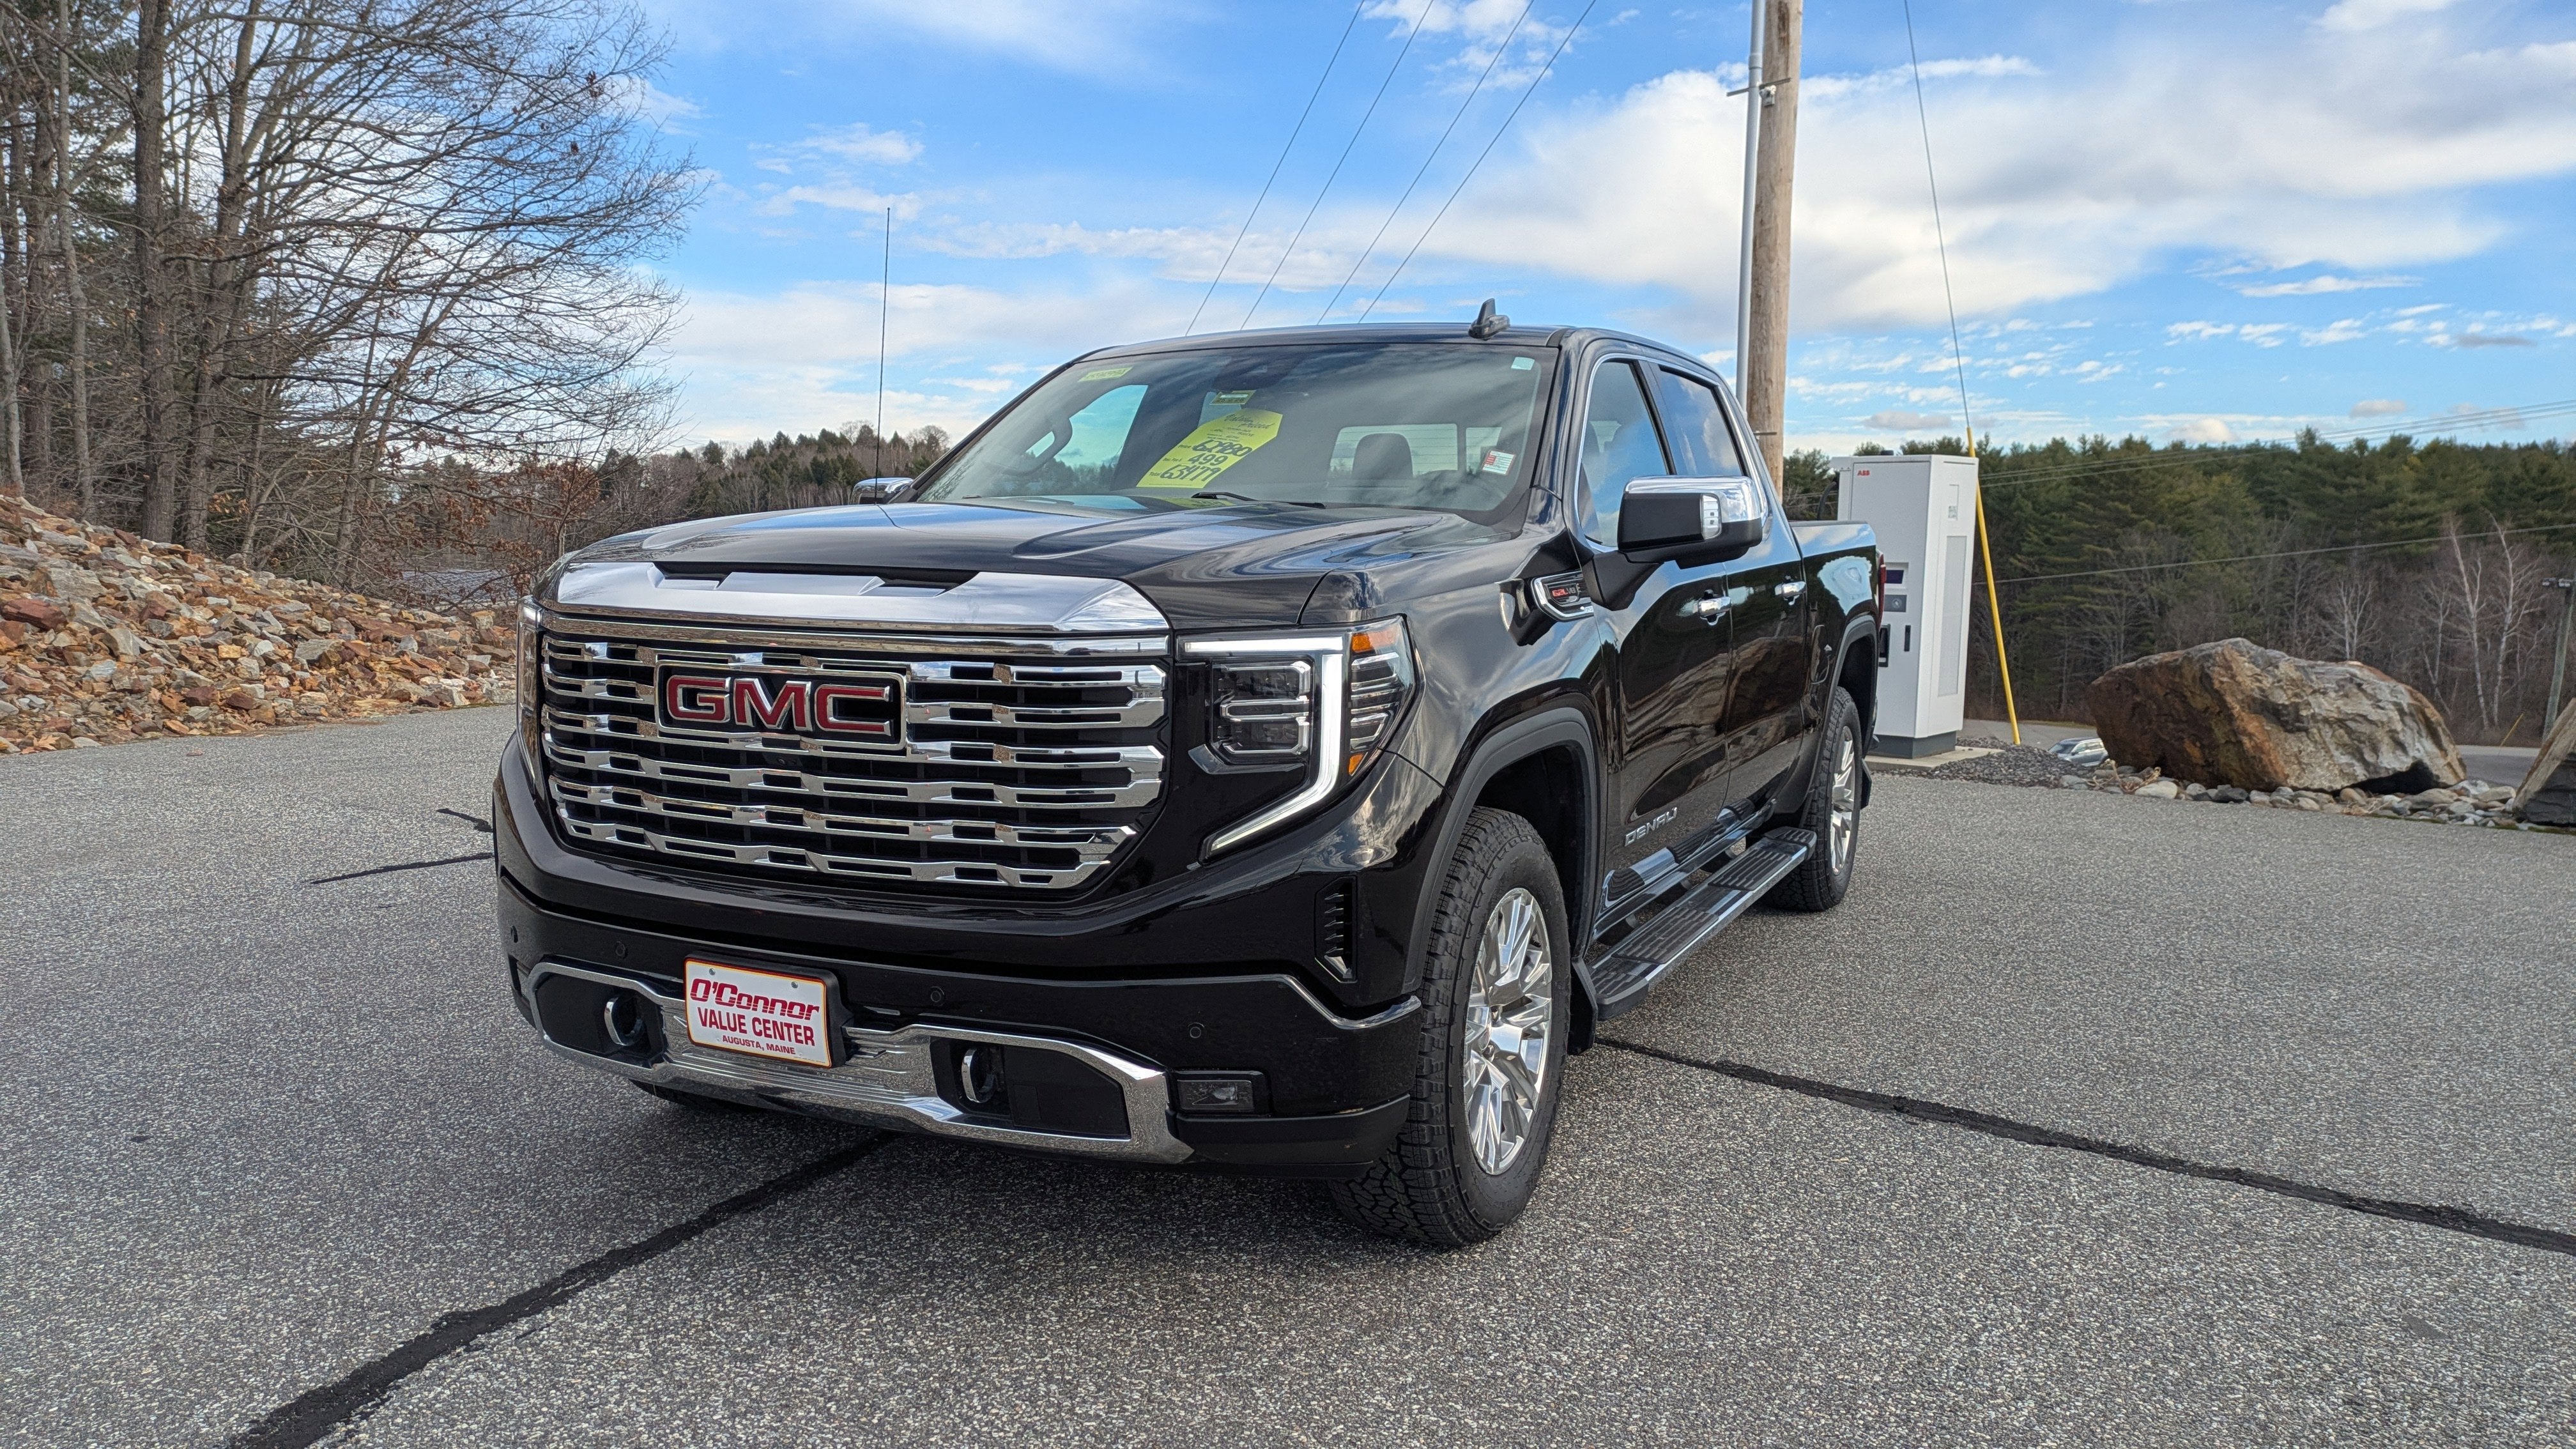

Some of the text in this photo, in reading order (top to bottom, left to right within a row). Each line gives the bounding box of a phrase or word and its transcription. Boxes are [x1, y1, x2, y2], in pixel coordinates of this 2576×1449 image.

[1160, 464, 1222, 482] 63479
[1188, 453, 1229, 466] 499
[667, 675, 891, 736] GMC
[1624, 807, 1678, 847] DENALI
[690, 978, 820, 1020] O'Connor
[697, 1007, 815, 1046] VALUE CENTER
[722, 1035, 795, 1054] AUGUSTA, MAINE
